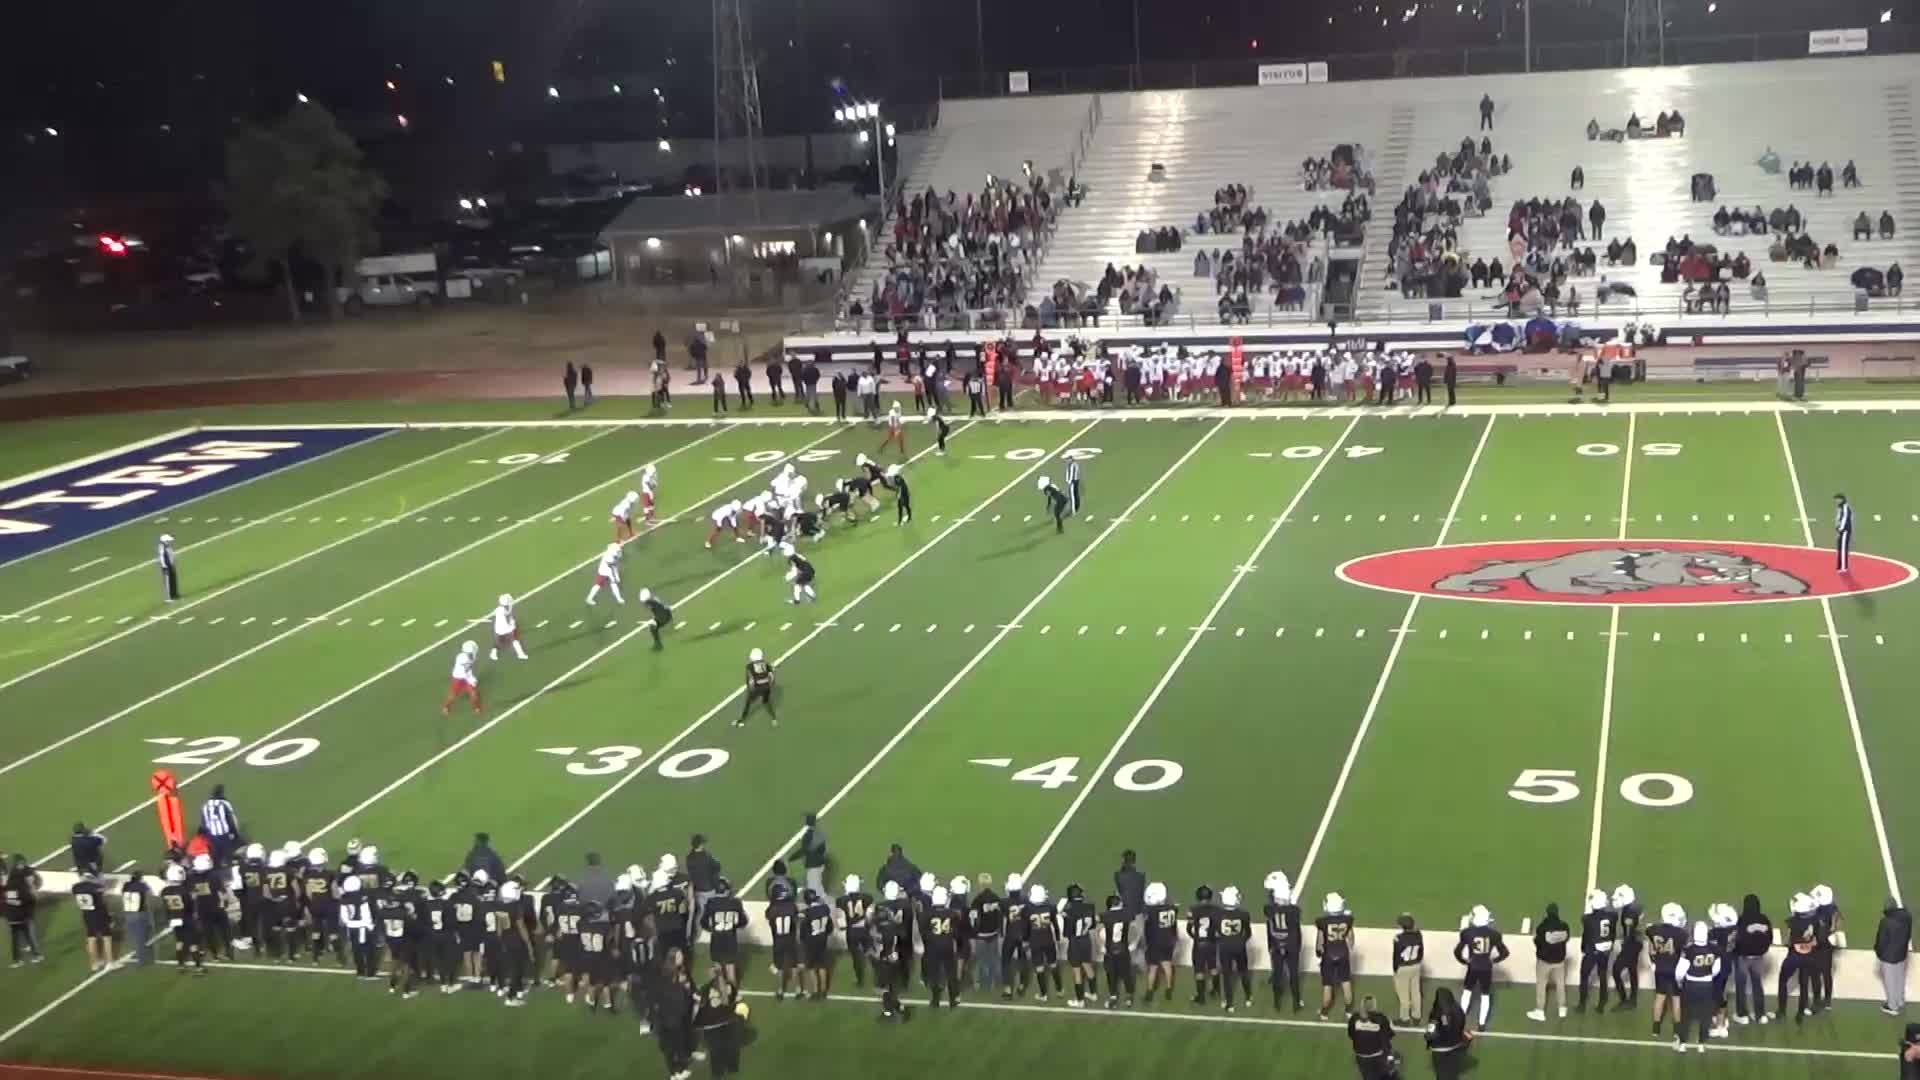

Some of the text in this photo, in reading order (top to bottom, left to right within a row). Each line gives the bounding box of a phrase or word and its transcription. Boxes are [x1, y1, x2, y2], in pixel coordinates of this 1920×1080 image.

[151, 736, 320, 766] 20
[565, 745, 731, 779] 30
[1011, 756, 1185, 792] 40
[1507, 769, 1694, 807] 50
[1472, 937, 1491, 955] 31
